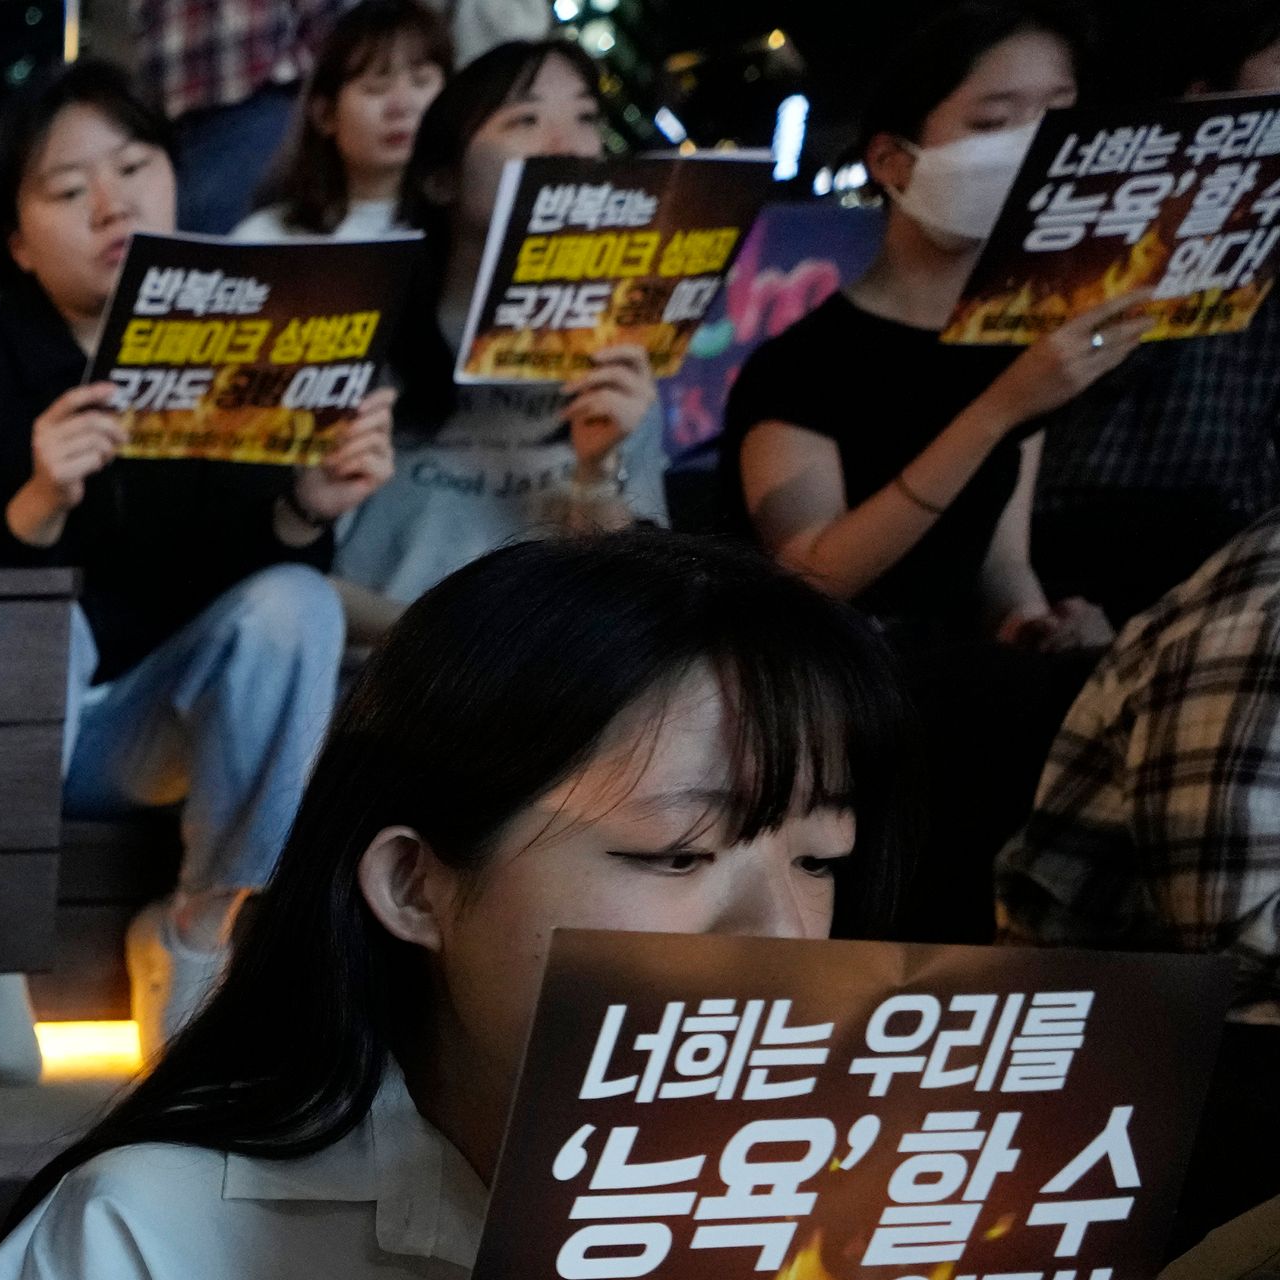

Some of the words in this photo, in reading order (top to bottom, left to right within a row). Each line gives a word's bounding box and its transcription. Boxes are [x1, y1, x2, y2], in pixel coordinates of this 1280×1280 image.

[1047, 124, 1184, 178] 너희는
[527, 182, 658, 233] 반복되는
[512, 231, 660, 283] 딥페이크
[1151, 226, 1280, 300] 없다!
[133, 266, 271, 316] 반복되는
[494, 283, 611, 331] 국가도
[117, 318, 272, 365] 딥페이크
[269, 309, 380, 364] 성범죄
[107, 368, 214, 411] 국가도
[579, 998, 833, 1103] 너희는
[849, 991, 1094, 1097] 우리를
[1026, 1105, 1141, 1257] 수
